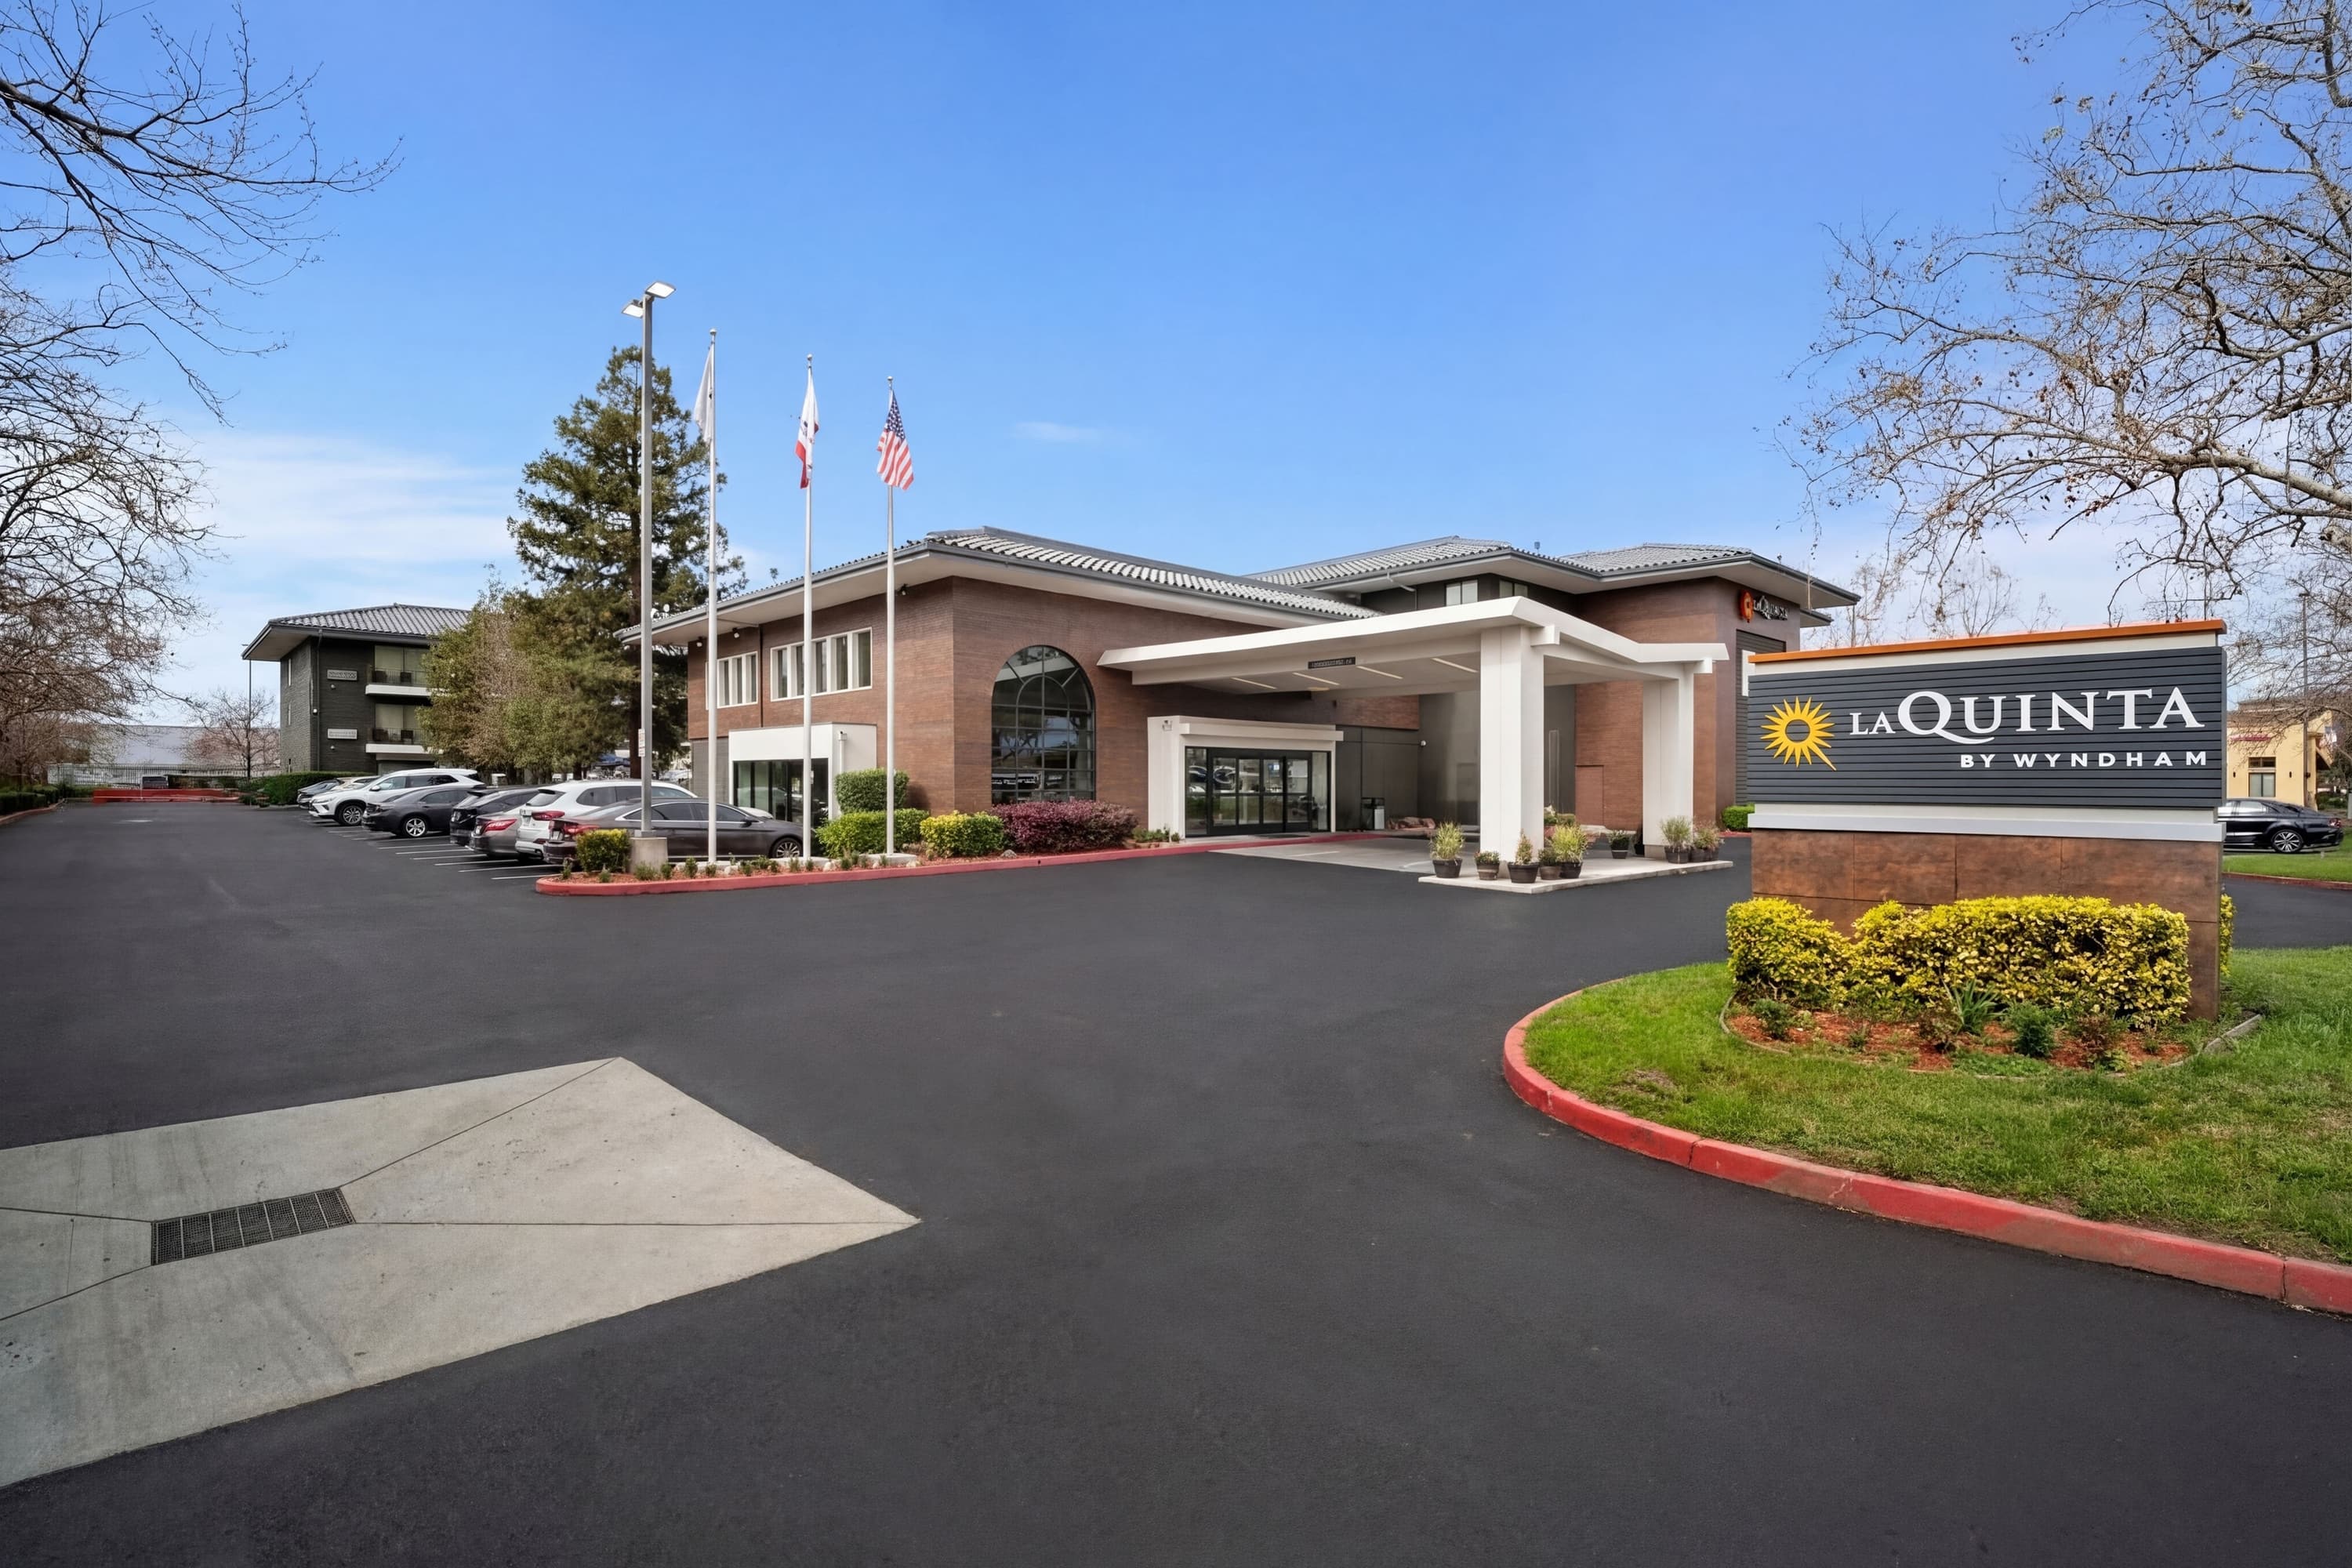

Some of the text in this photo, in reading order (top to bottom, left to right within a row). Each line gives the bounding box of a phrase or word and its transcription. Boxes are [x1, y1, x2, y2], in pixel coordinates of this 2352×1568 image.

[1849, 687, 2206, 745] LA QUINTA
[1960, 750, 2207, 768] BY WYNDHAM
